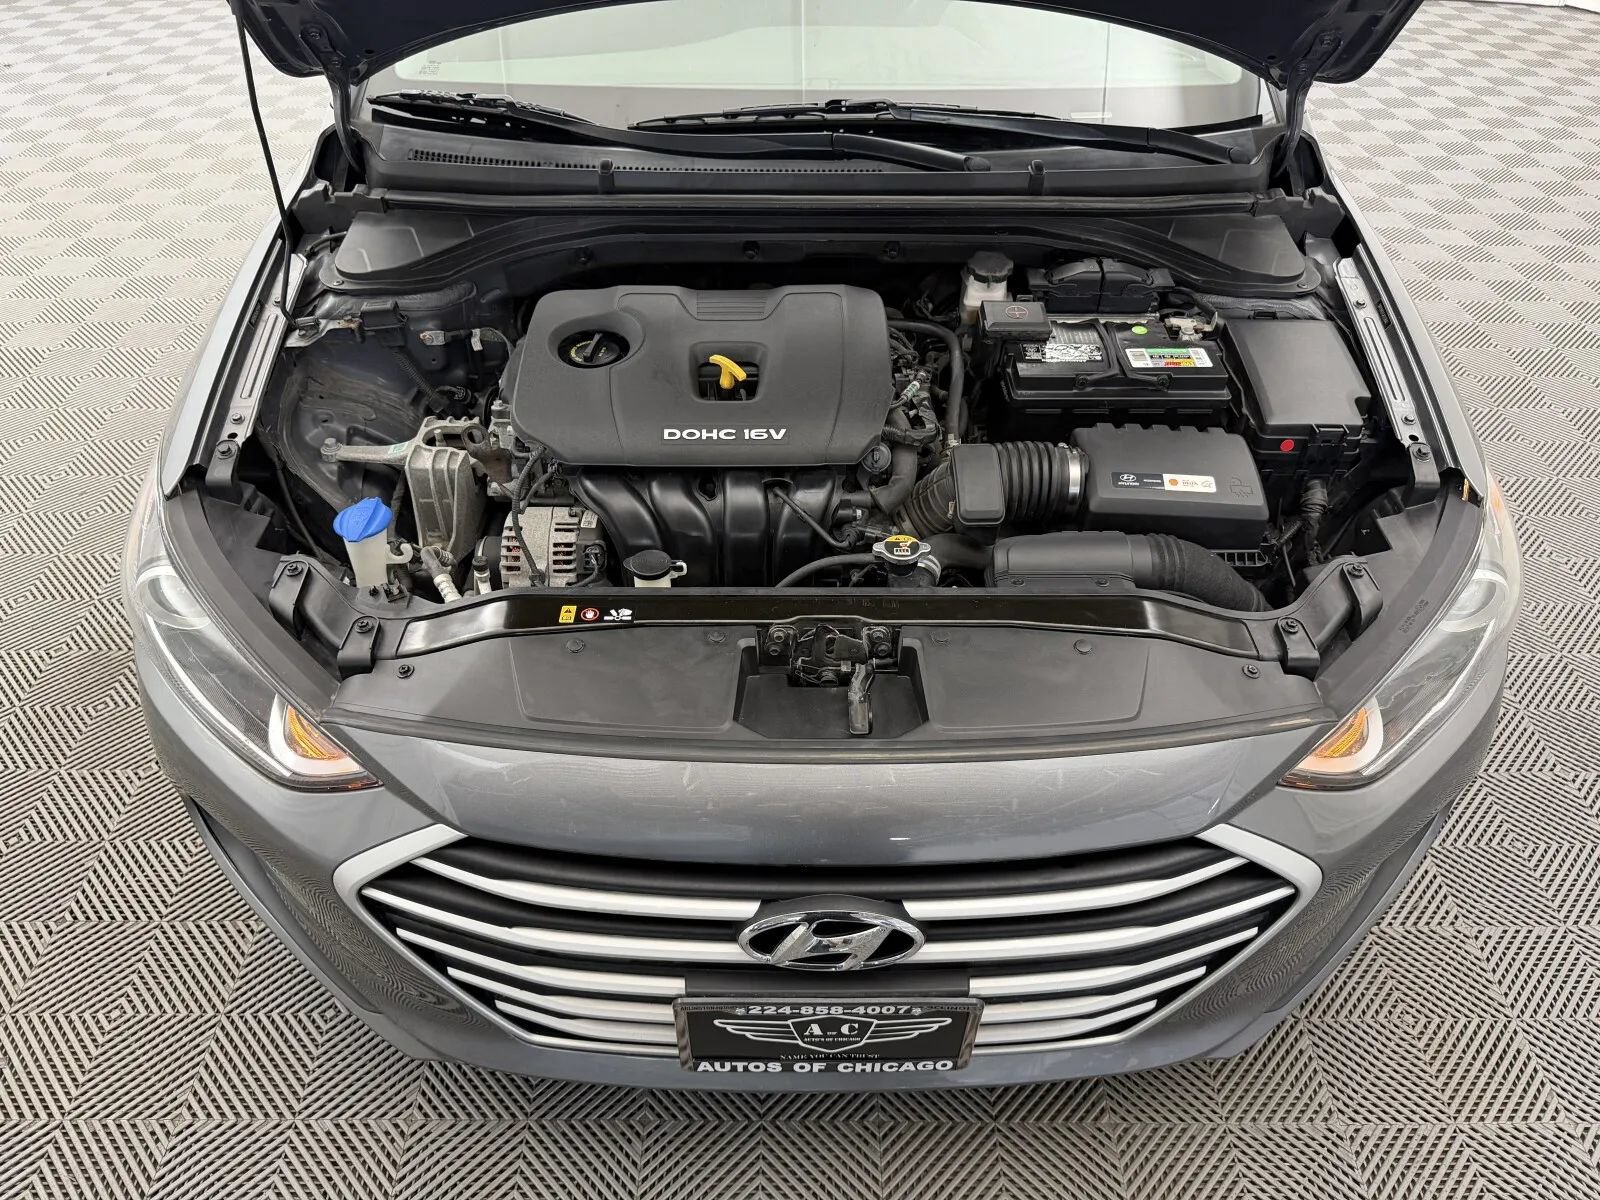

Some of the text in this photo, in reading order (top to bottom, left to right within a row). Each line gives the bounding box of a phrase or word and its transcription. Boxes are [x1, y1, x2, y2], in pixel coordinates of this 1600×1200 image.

[663, 428, 787, 440] DOHC 16V
[747, 1005, 911, 1015] 224-858-4007
[803, 1023, 824, 1036] A
[840, 1023, 859, 1035] C
[696, 1060, 954, 1073] AUTOS OF CHICAGO
